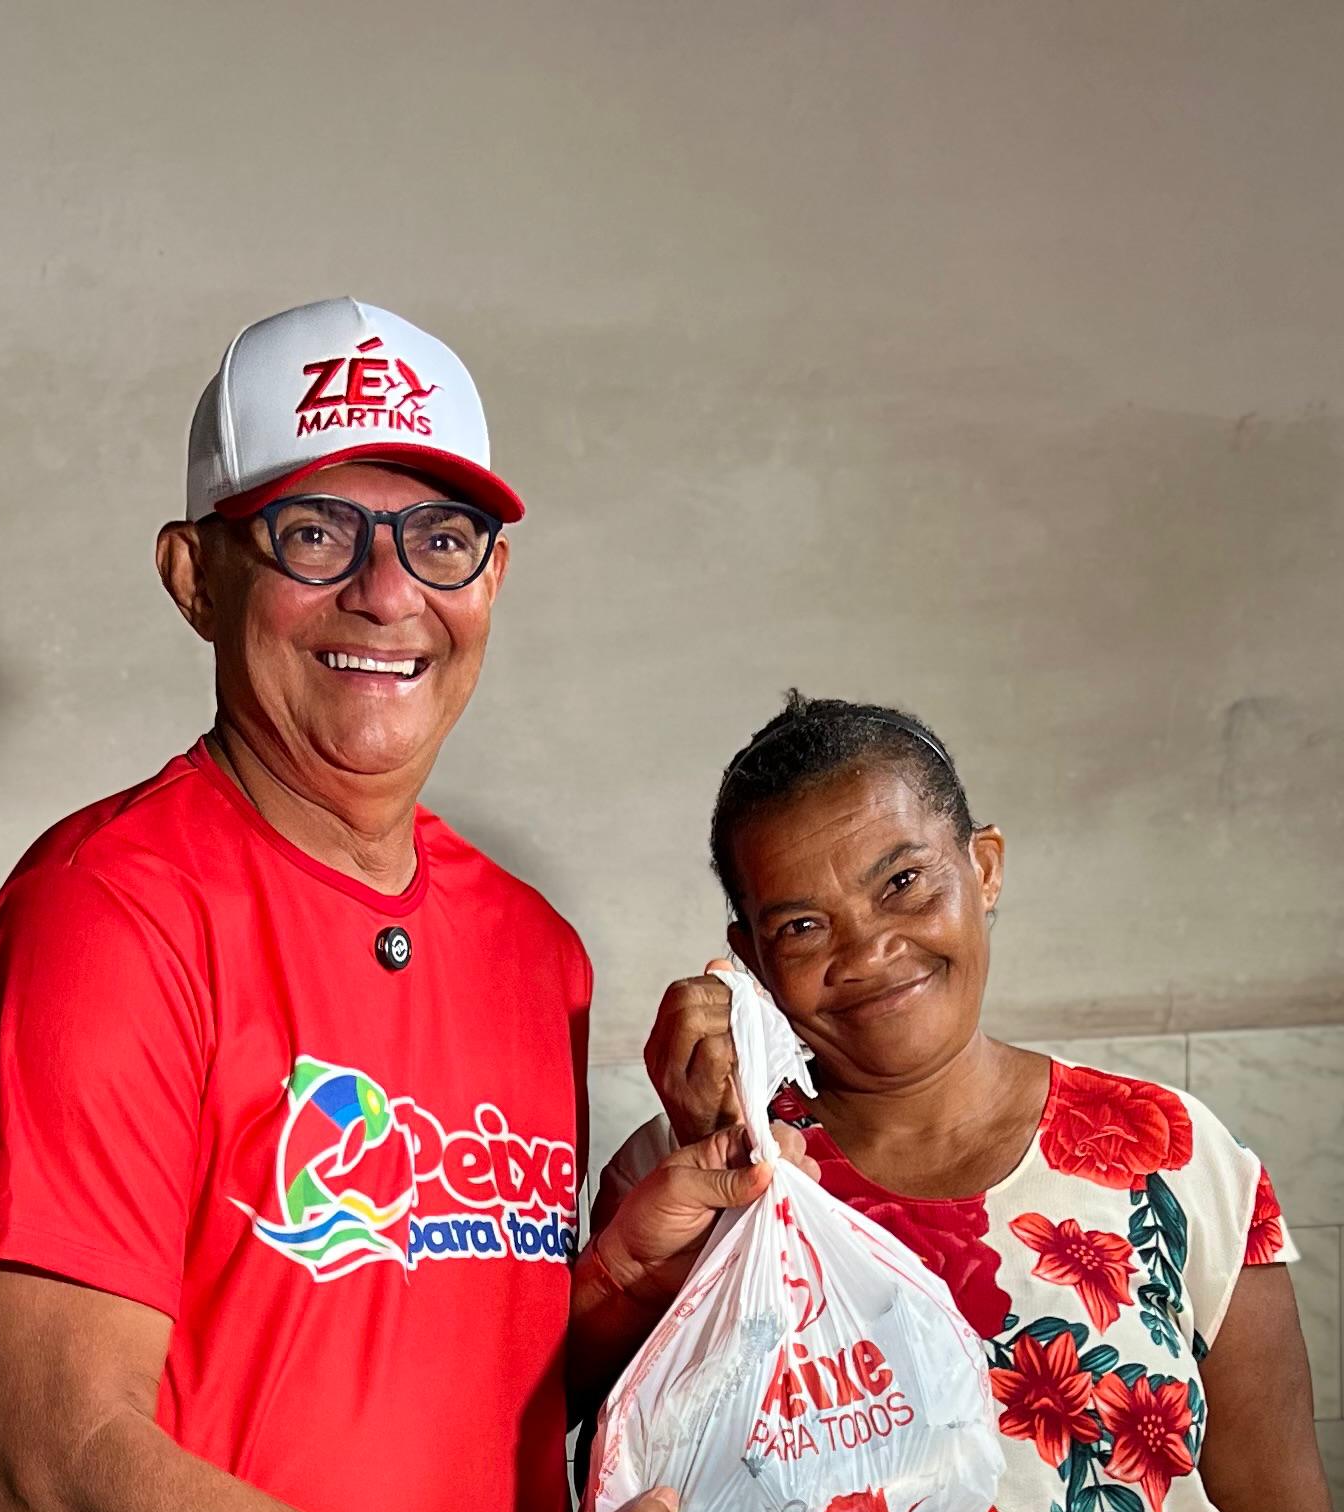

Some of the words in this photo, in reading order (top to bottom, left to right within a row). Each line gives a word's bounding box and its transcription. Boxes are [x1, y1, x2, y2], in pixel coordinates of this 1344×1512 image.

[295, 336, 390, 414] ZÉ
[296, 407, 433, 438] MARTINS
[390, 1098, 575, 1214] Peixe
[407, 1215, 503, 1264] para
[746, 1418, 819, 1461] PARA
[819, 1391, 915, 1451] TODOS
